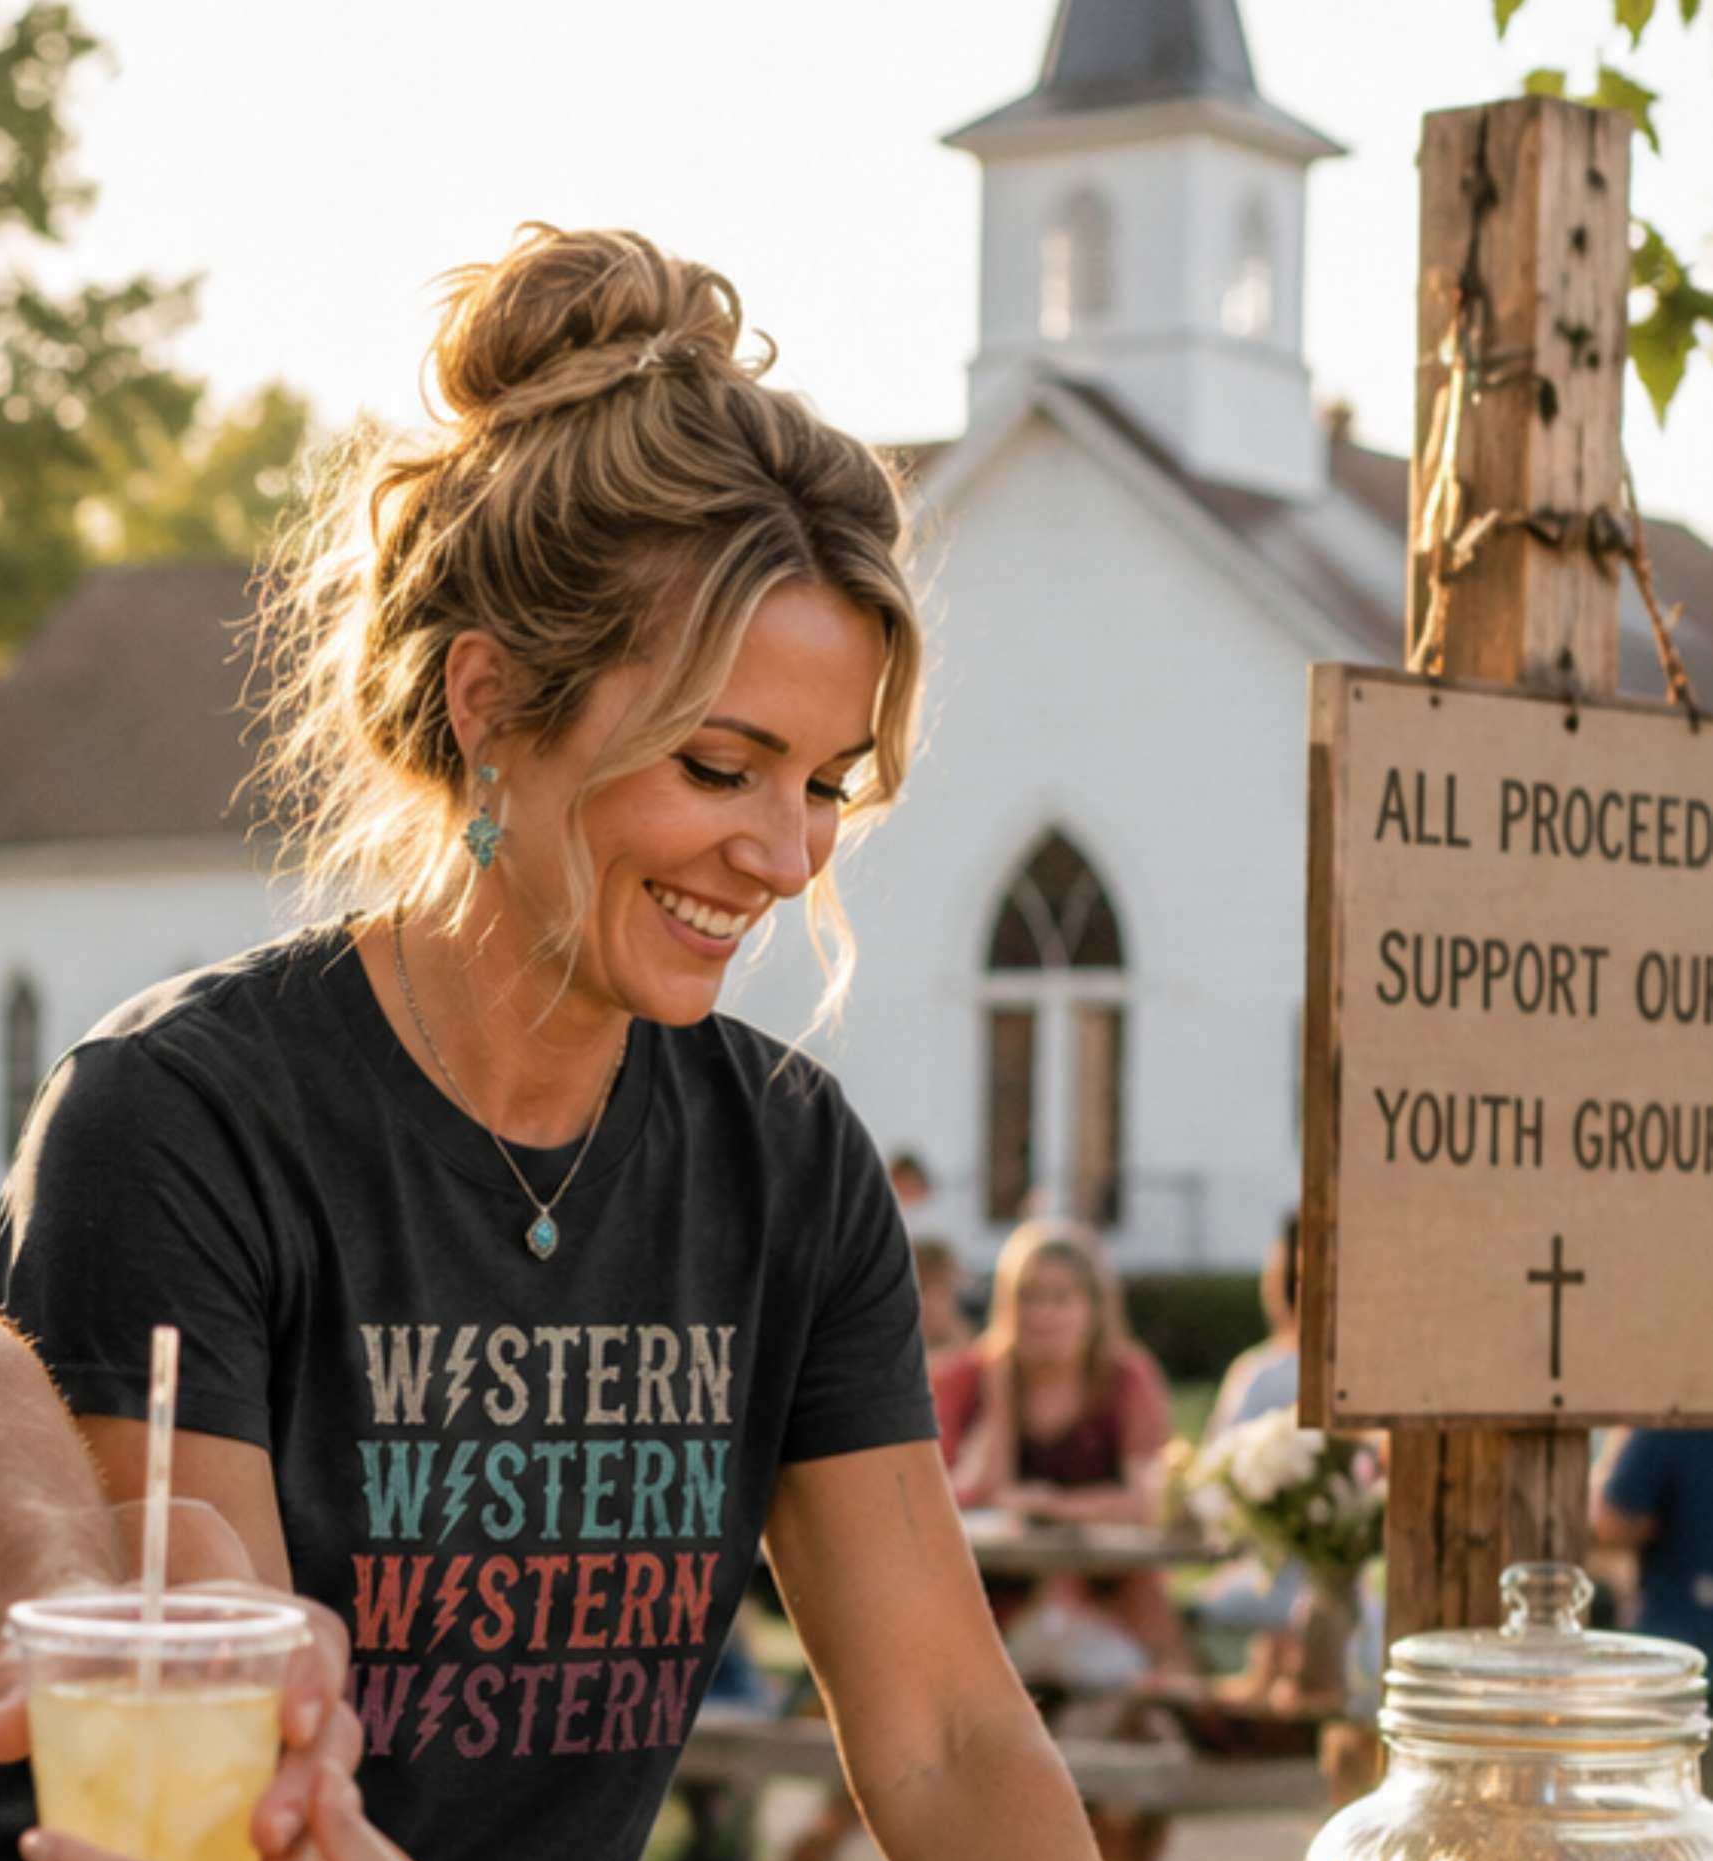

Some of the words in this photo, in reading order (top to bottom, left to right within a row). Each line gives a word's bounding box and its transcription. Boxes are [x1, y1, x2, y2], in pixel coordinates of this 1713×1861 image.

[1375, 767, 1471, 848] ALL
[1376, 931, 1609, 1018] SUPPORT
[1374, 1087, 1544, 1168] YOUTH
